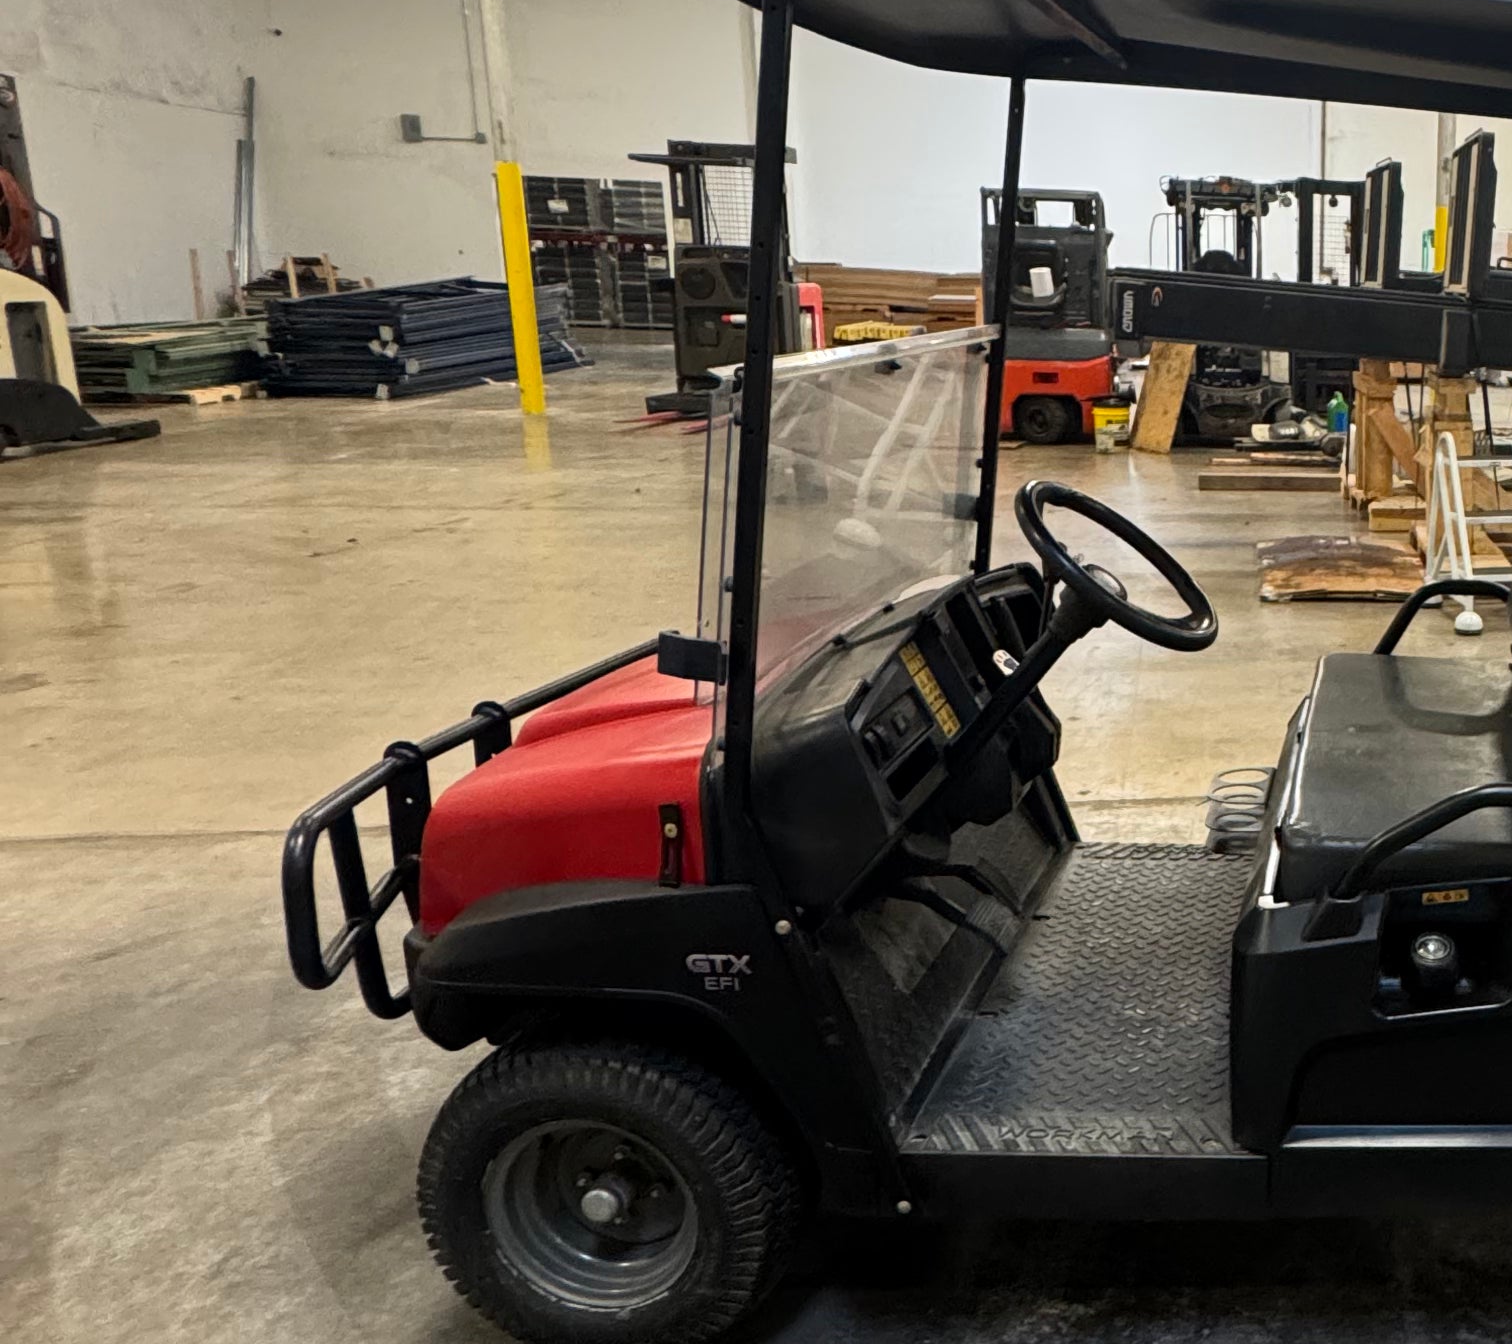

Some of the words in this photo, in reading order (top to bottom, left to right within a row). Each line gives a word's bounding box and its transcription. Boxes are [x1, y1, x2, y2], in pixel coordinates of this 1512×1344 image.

[1122, 290, 1134, 333] CROWN
[685, 953, 752, 974] GTX
[704, 976, 740, 991] EFI
